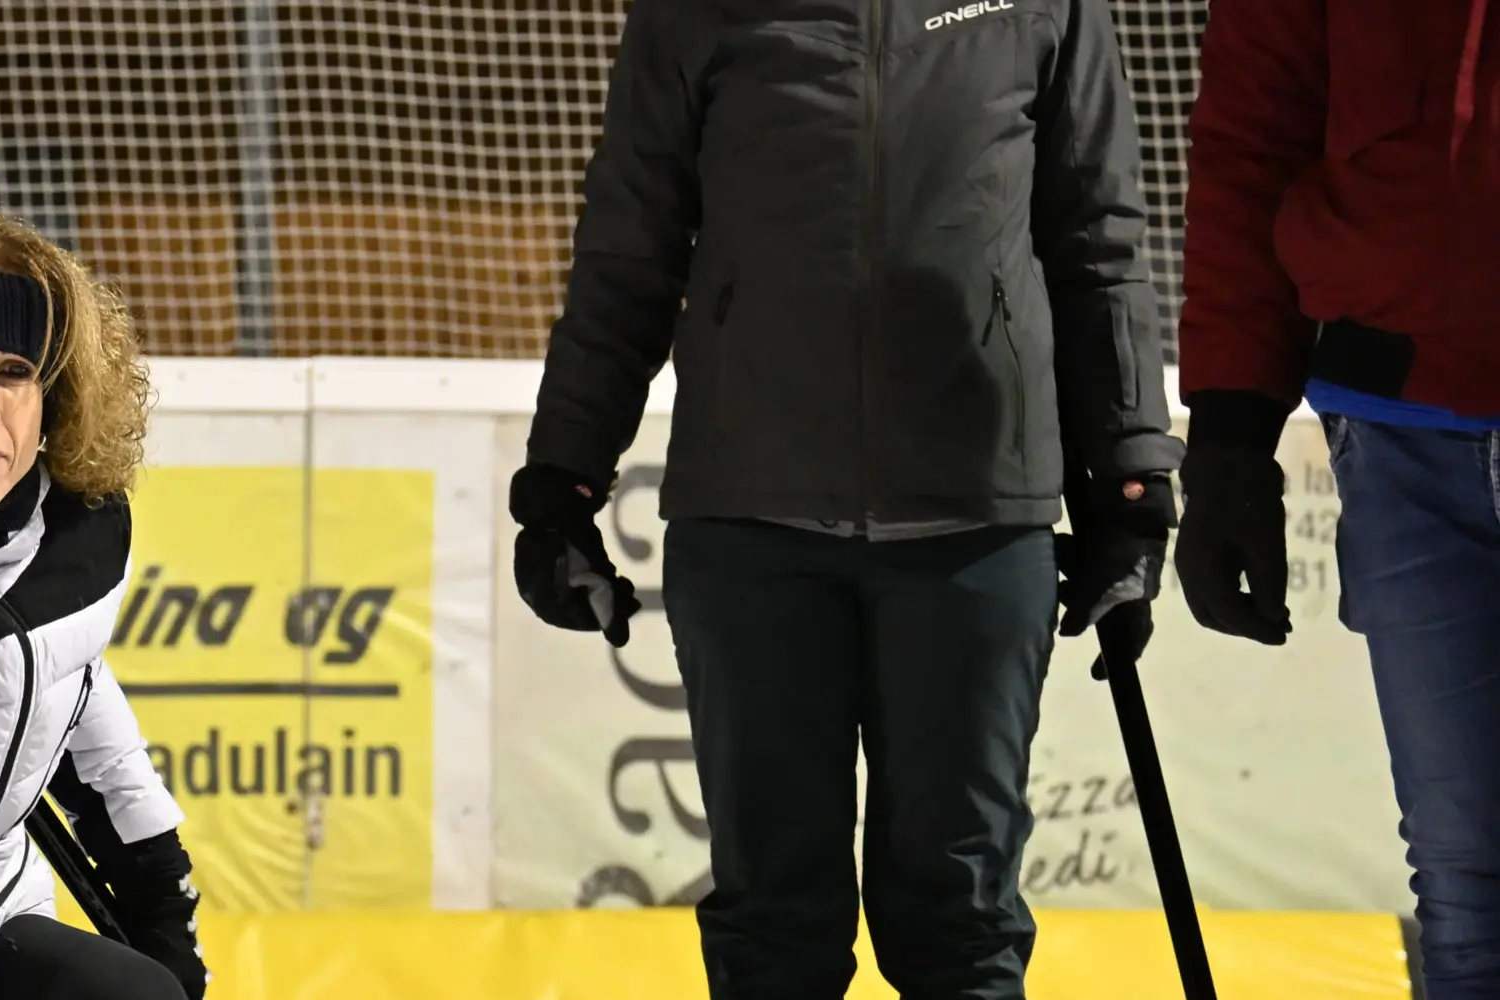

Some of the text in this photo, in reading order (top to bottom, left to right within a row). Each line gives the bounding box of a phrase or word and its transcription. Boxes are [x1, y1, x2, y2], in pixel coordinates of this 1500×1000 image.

[107, 565, 397, 666] ina ag
[145, 725, 402, 799] adulain
